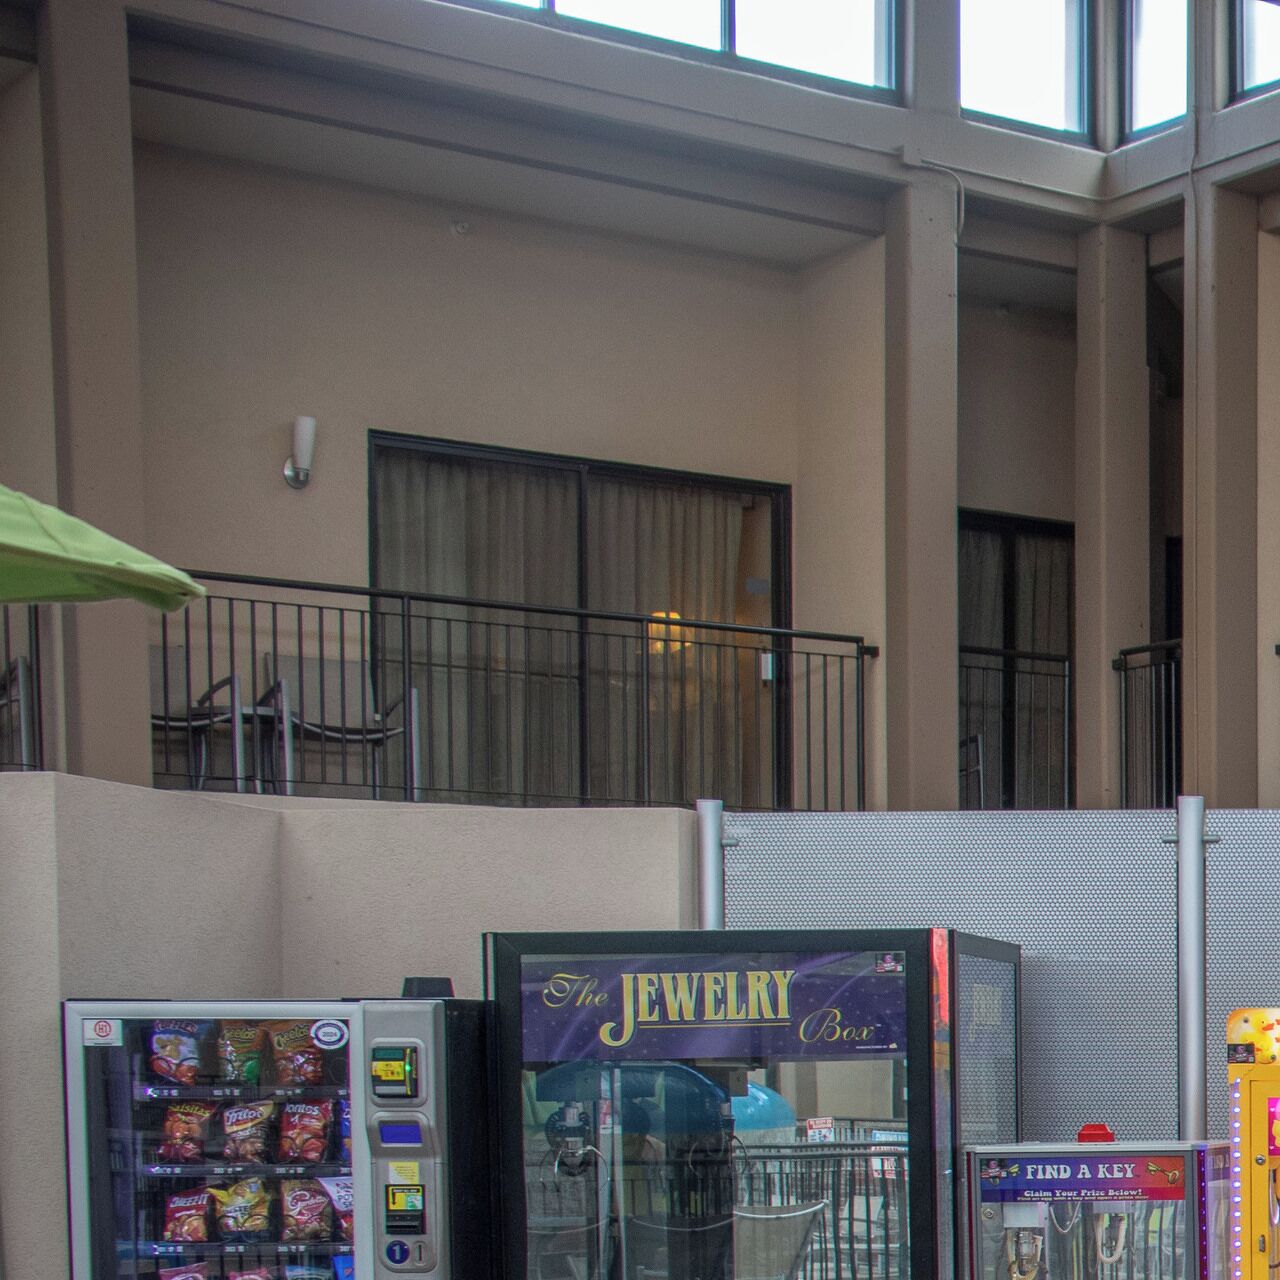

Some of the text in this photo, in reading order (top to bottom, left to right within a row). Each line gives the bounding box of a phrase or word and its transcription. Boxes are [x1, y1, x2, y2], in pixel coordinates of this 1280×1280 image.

[543, 970, 875, 1047] The JEWELRY Box
[1026, 1164, 1136, 1180] FIND A KEY
[1108, 1188, 1142, 1196] Below!
